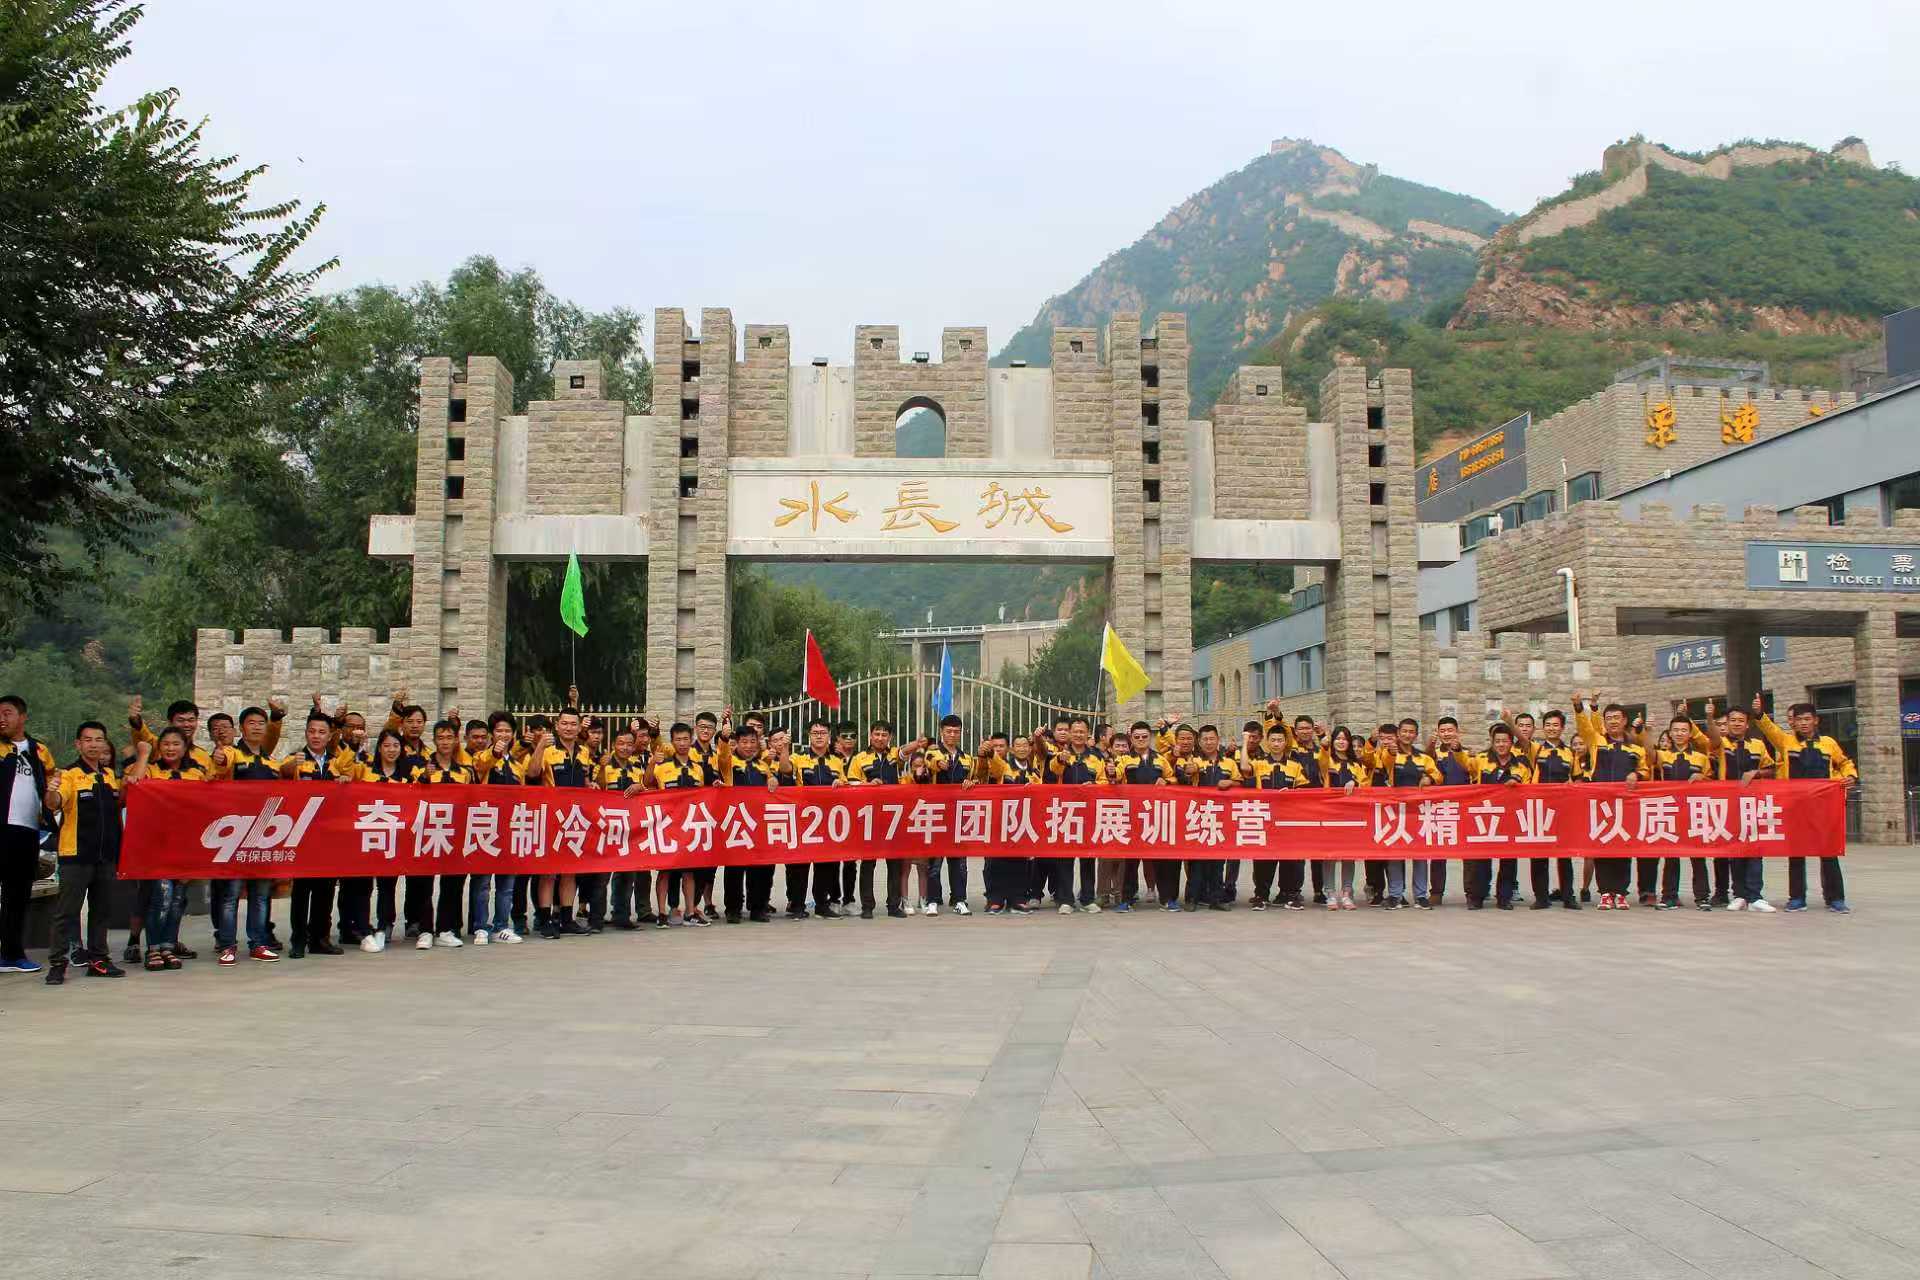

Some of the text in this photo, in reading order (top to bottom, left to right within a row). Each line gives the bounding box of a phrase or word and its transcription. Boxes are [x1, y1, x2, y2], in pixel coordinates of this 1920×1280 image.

[1831, 575, 1884, 585] TICKET
[1588, 795, 1786, 844] 以质取胜
[236, 850, 297, 863] 奇保良制冷
